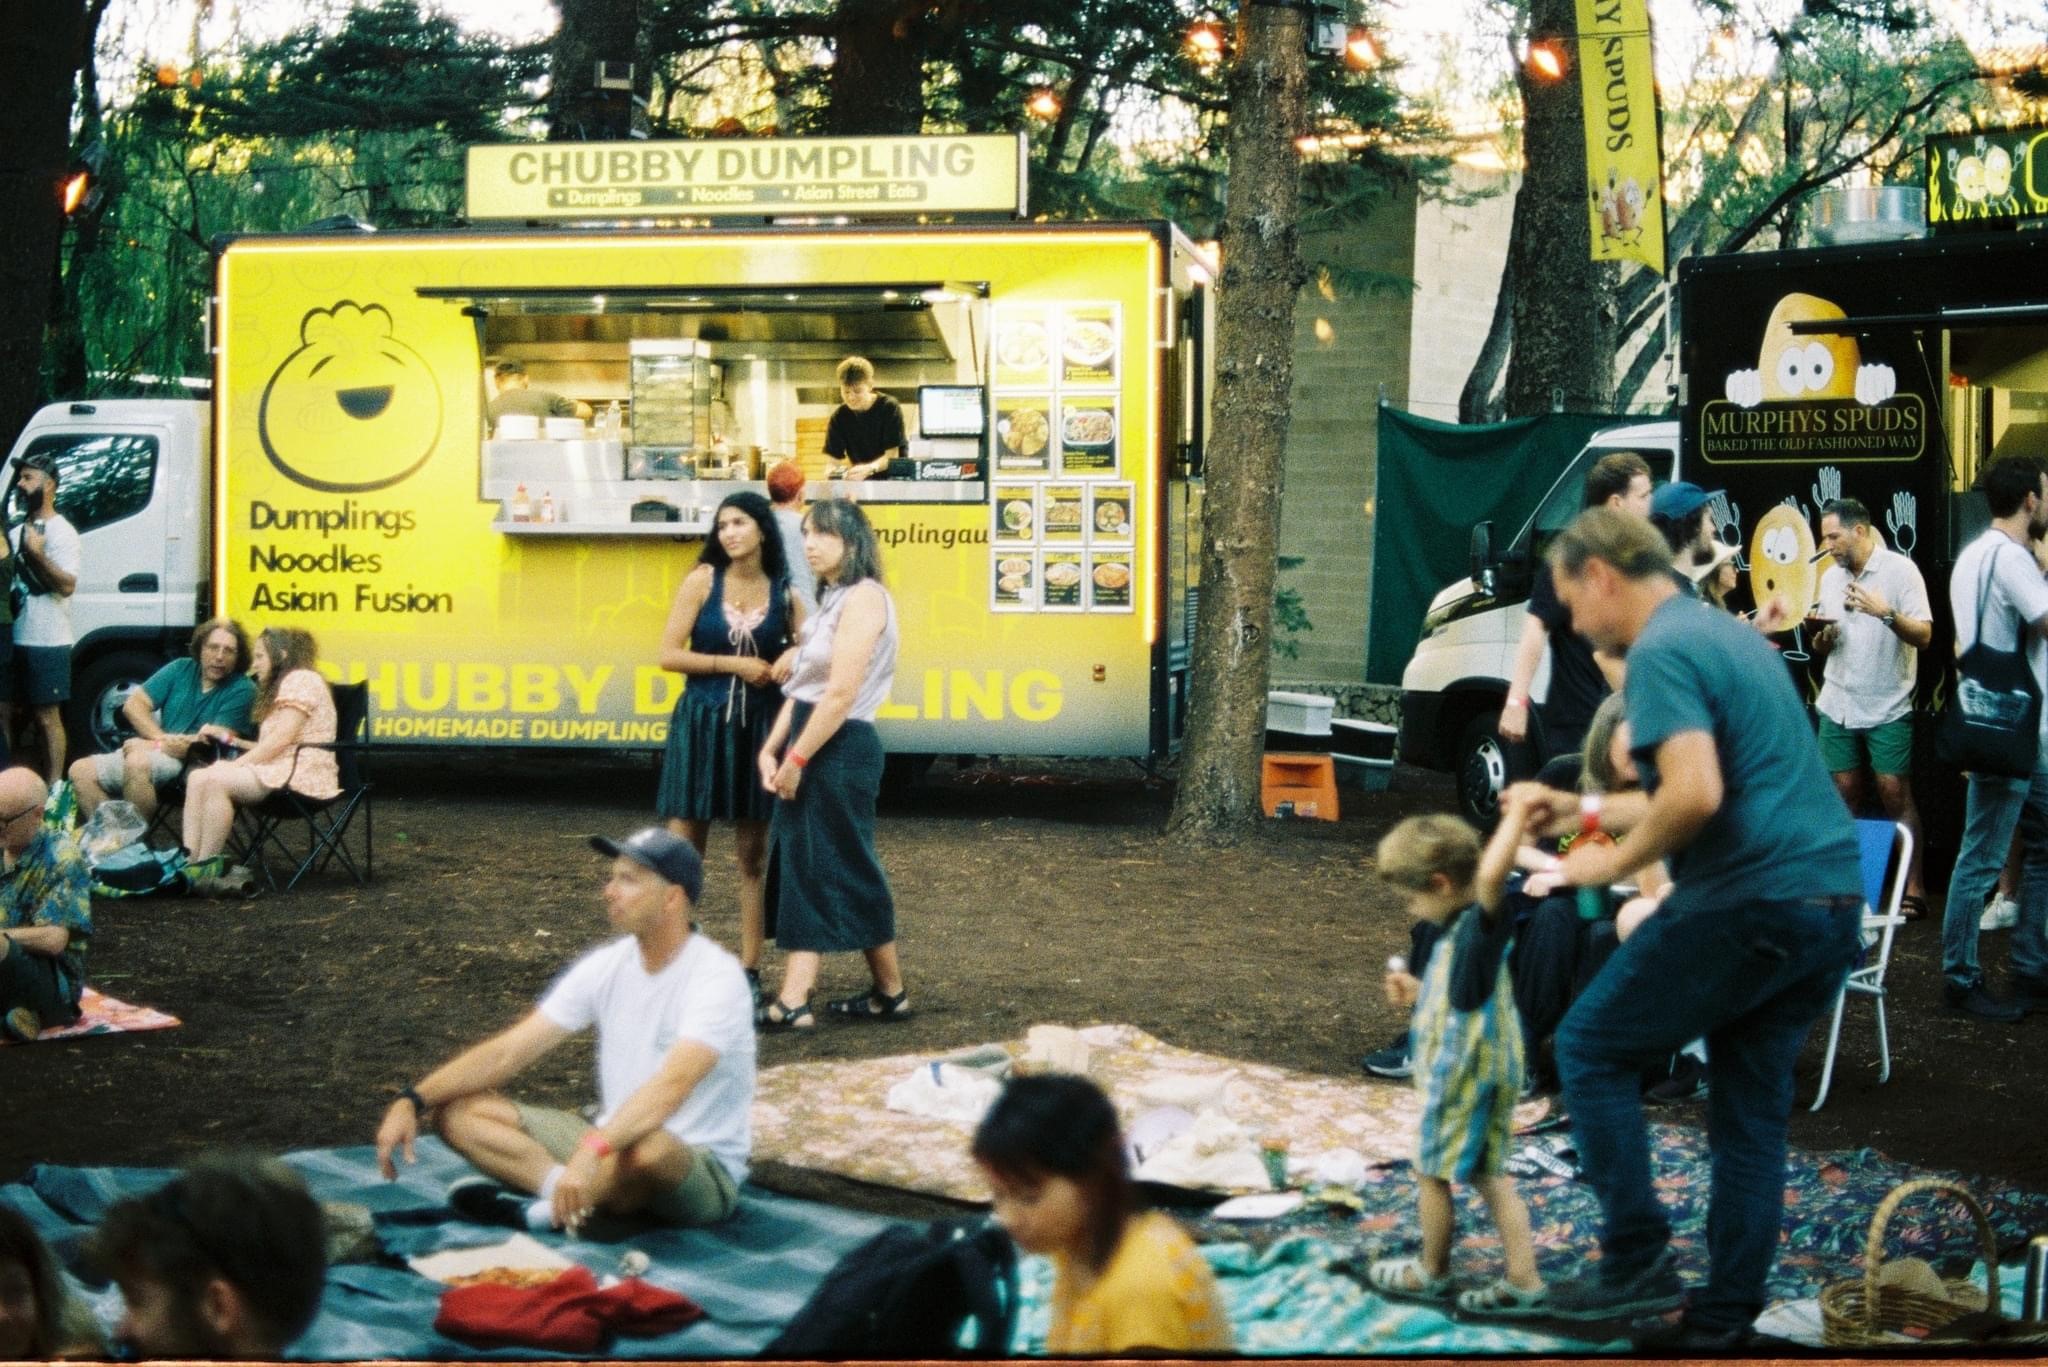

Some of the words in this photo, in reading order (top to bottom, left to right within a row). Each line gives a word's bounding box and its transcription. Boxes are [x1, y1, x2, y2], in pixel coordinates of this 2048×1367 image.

[1602, 36, 1633, 152] SPUDS
[509, 148, 704, 185] CHUBBY
[717, 143, 975, 181] DUMPLING
[568, 188, 642, 207] Dumplings
[692, 186, 754, 203] Noodles
[794, 184, 834, 201] Asian
[838, 183, 880, 200] Street
[889, 182, 918, 199] Eats
[1707, 408, 1827, 435] MURPHYS
[1834, 406, 1919, 432] SPUDS
[1707, 438, 1748, 452] BAKED
[1750, 438, 1777, 451] THE
[1779, 437, 1807, 450] OLD
[1808, 436, 1885, 450] FASHIONED
[1887, 434, 1919, 449] WAY
[250, 498, 417, 539] Dumplings
[250, 543, 383, 574] Noodles
[250, 581, 338, 612] Asian
[355, 582, 453, 614] Fusion
[315, 660, 615, 715] HUBBY
[373, 716, 524, 738] HOMEMADE
